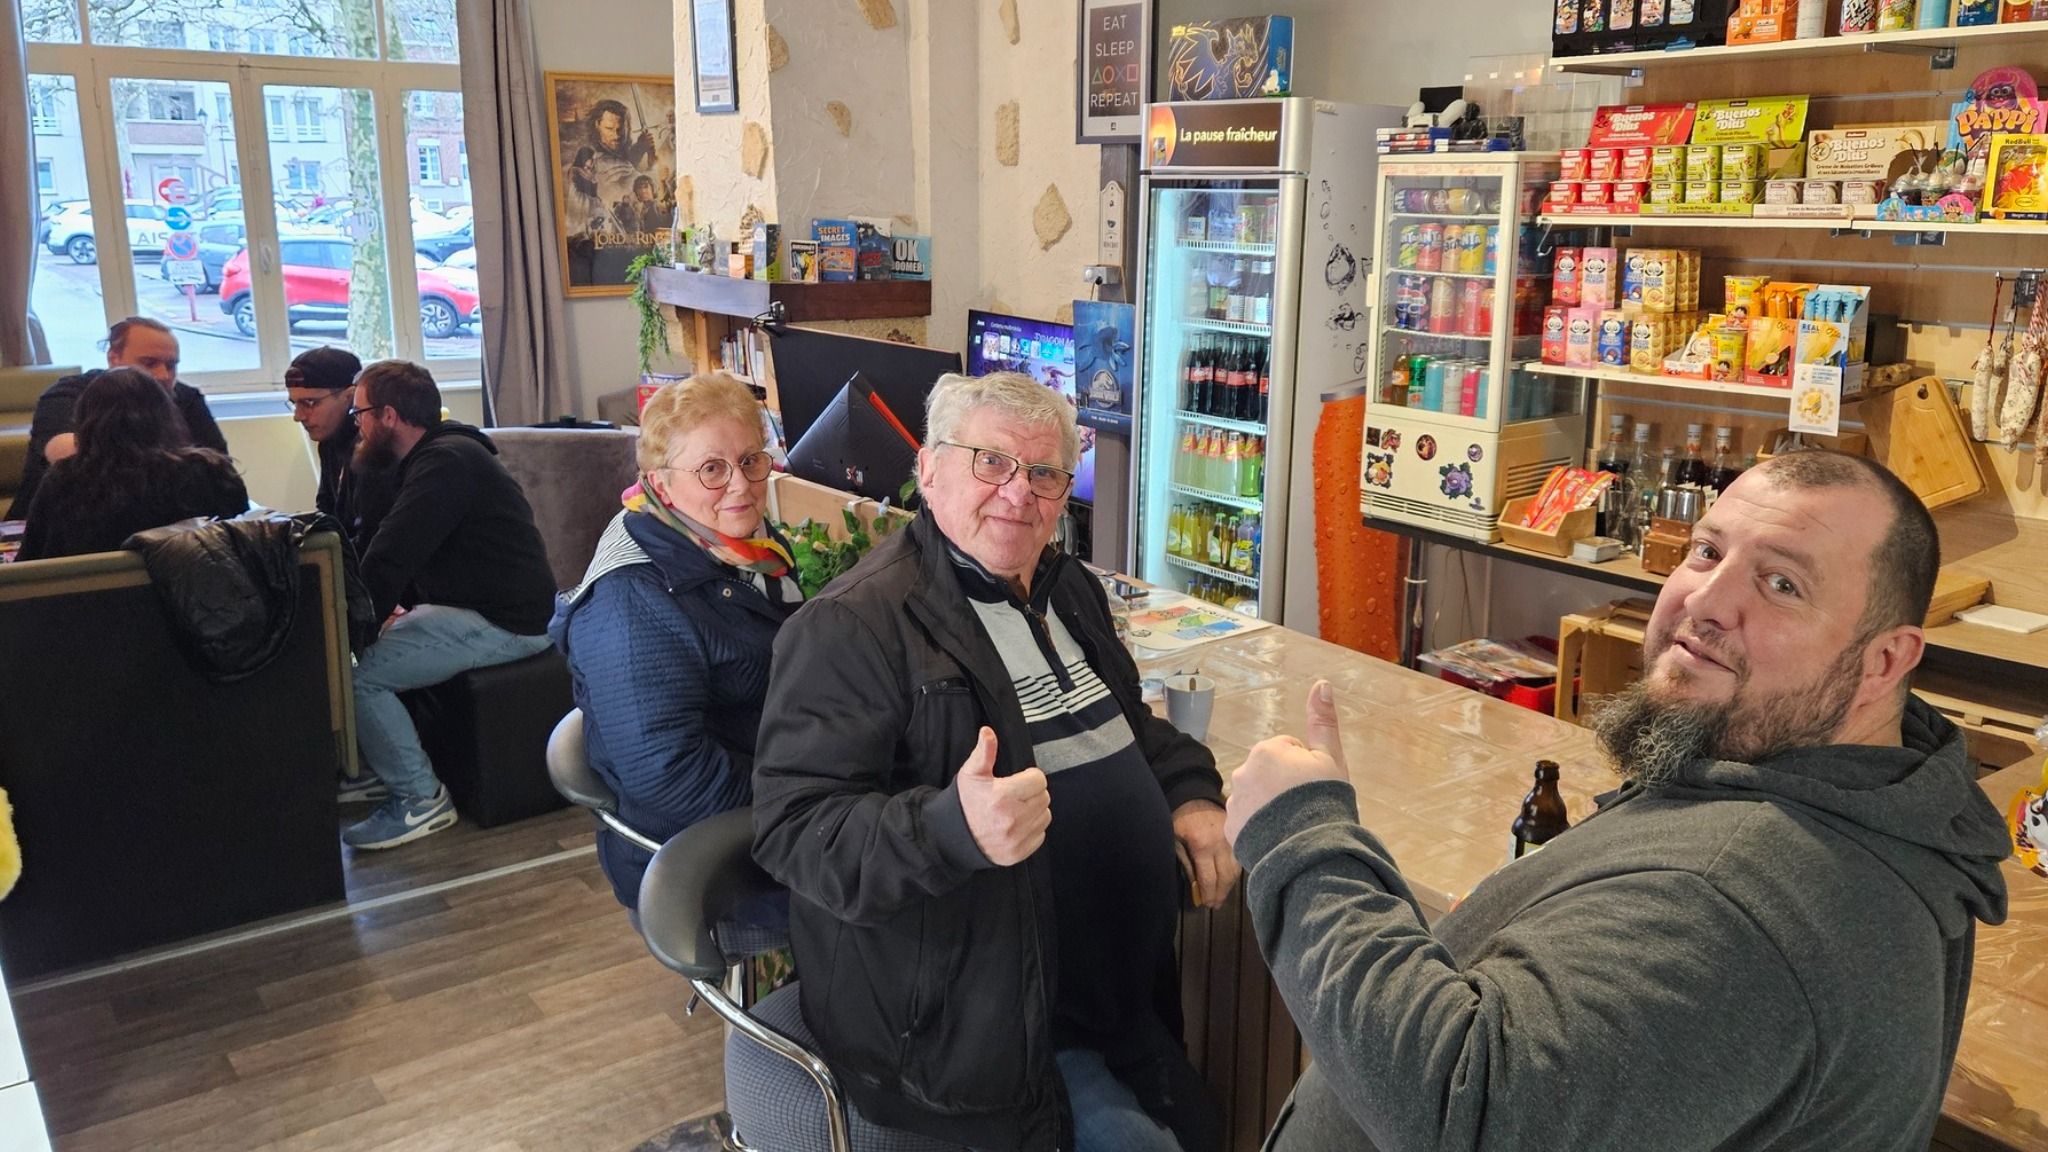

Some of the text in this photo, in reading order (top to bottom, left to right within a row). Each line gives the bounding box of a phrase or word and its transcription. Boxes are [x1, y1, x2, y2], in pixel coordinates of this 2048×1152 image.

[1103, 15, 1127, 31] EAT
[1095, 40, 1135, 57] SLEEP
[1090, 92, 1138, 108] REPEAT
[1714, 108, 1760, 120] Buenos
[1956, 109, 2039, 136] PAPPI
[1180, 126, 1278, 146] La pause fraîcheur
[1830, 137, 1886, 151] Buenos
[594, 229, 626, 250] LORD
[820, 234, 850, 242] IMAGES
[894, 239, 920, 262] OK
